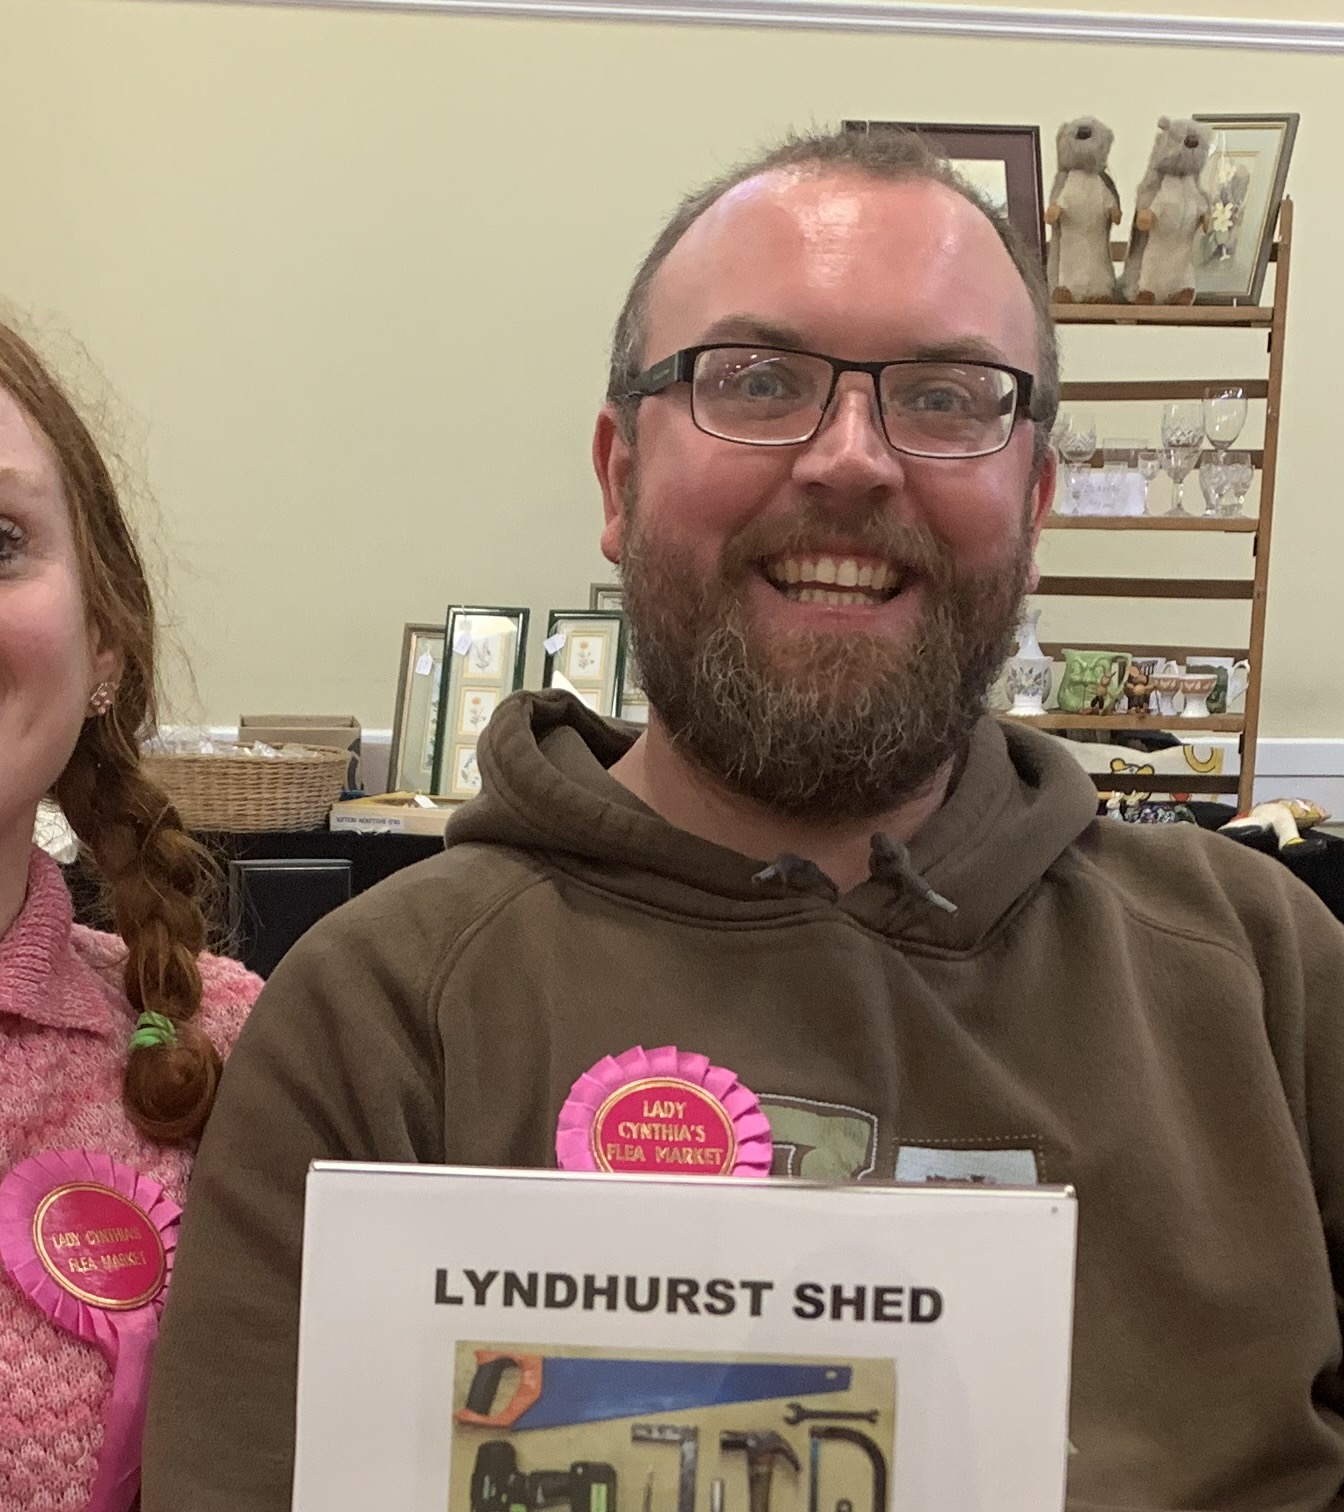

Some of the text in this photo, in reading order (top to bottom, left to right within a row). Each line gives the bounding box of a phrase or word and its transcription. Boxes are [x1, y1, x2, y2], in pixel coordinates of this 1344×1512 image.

[643, 1100, 687, 1119] LADY
[618, 1122, 706, 1142] CYNTHIA'S
[607, 1144, 724, 1165] FLEA MARKET
[52, 1231, 81, 1249] LADY
[69, 1251, 146, 1273] FLEA MARKET
[434, 1267, 944, 1324] LYNDHURST SHED
